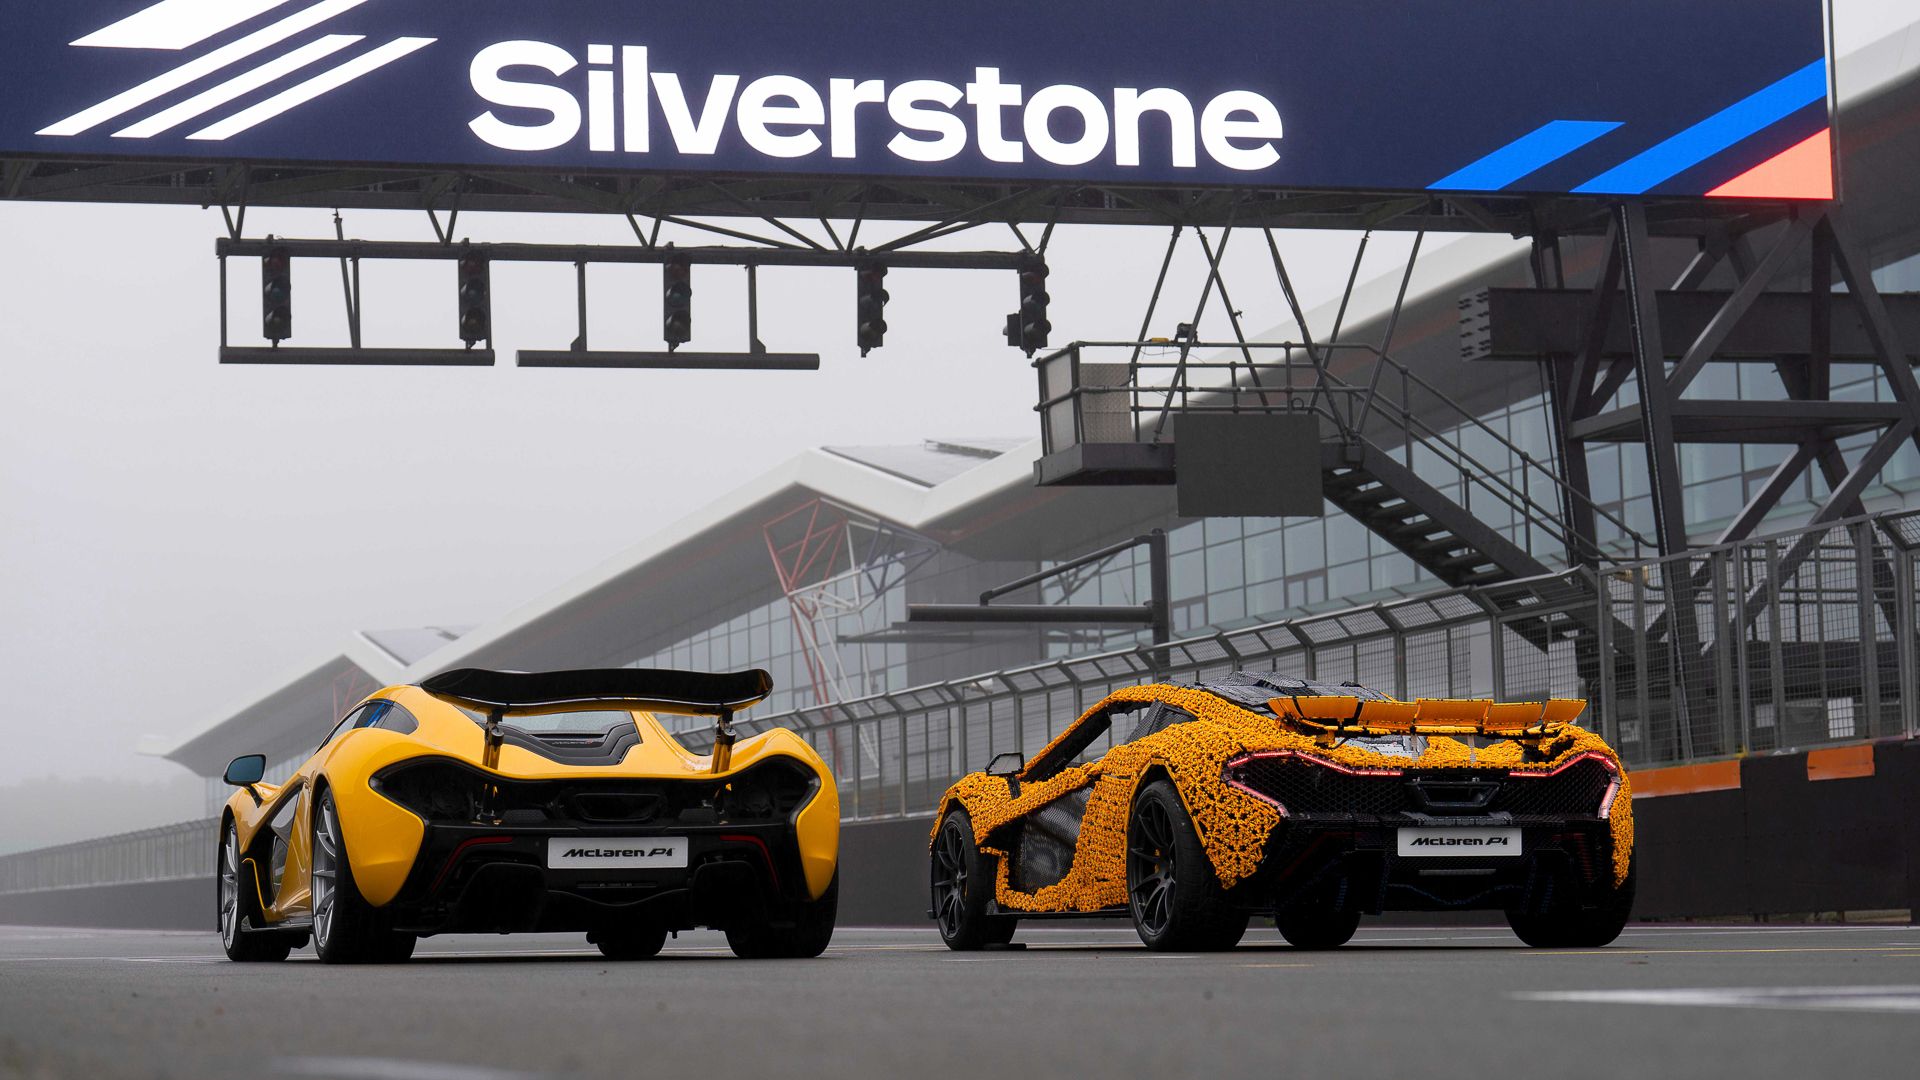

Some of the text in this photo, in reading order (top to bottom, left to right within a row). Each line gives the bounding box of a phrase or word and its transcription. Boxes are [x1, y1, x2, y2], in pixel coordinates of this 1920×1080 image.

[467, 40, 1284, 170] Silverstone
[1410, 837, 1508, 846] McLaren P1
[562, 848, 673, 857] McLaren P1
